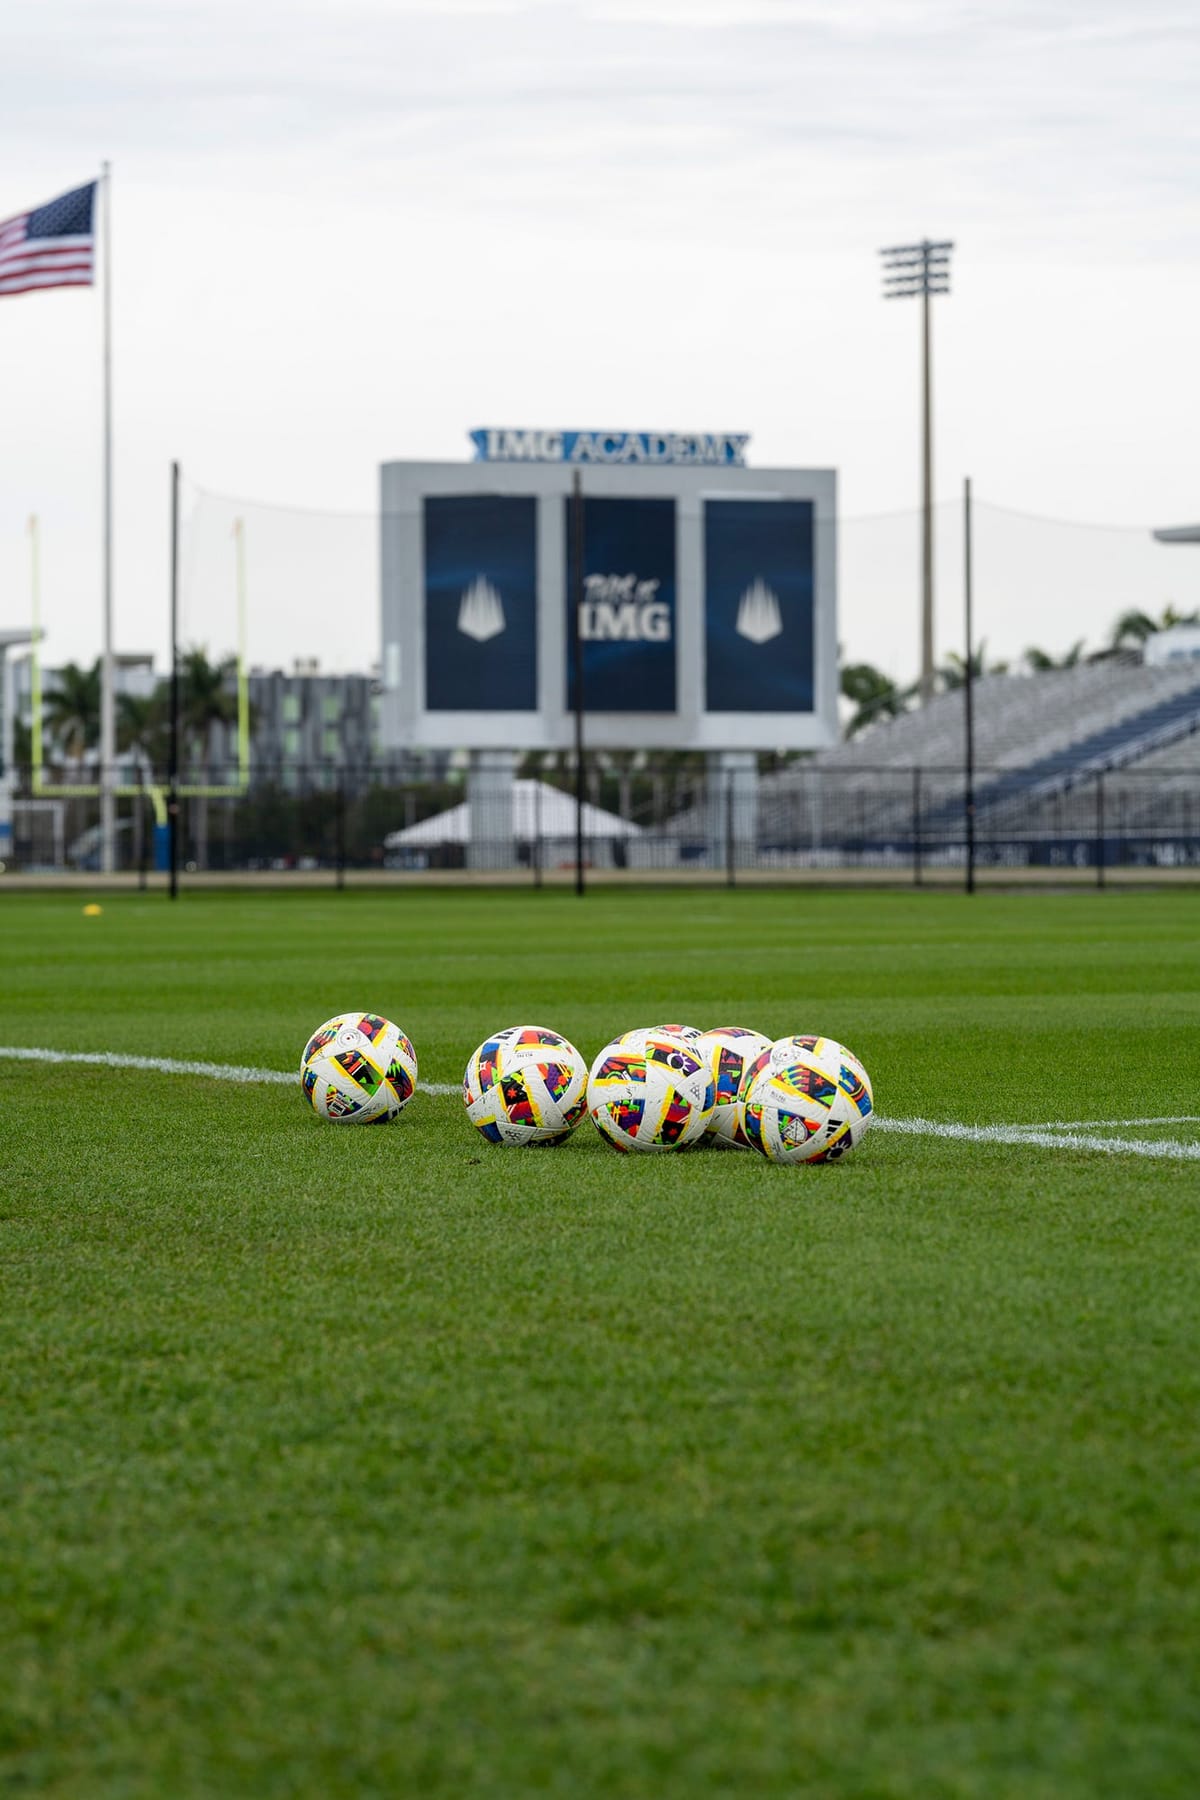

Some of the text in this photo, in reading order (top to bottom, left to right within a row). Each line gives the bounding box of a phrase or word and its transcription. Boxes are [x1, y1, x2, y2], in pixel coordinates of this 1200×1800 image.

[487, 430, 747, 465] IMG ACADEMY
[578, 602, 670, 641] IMG
